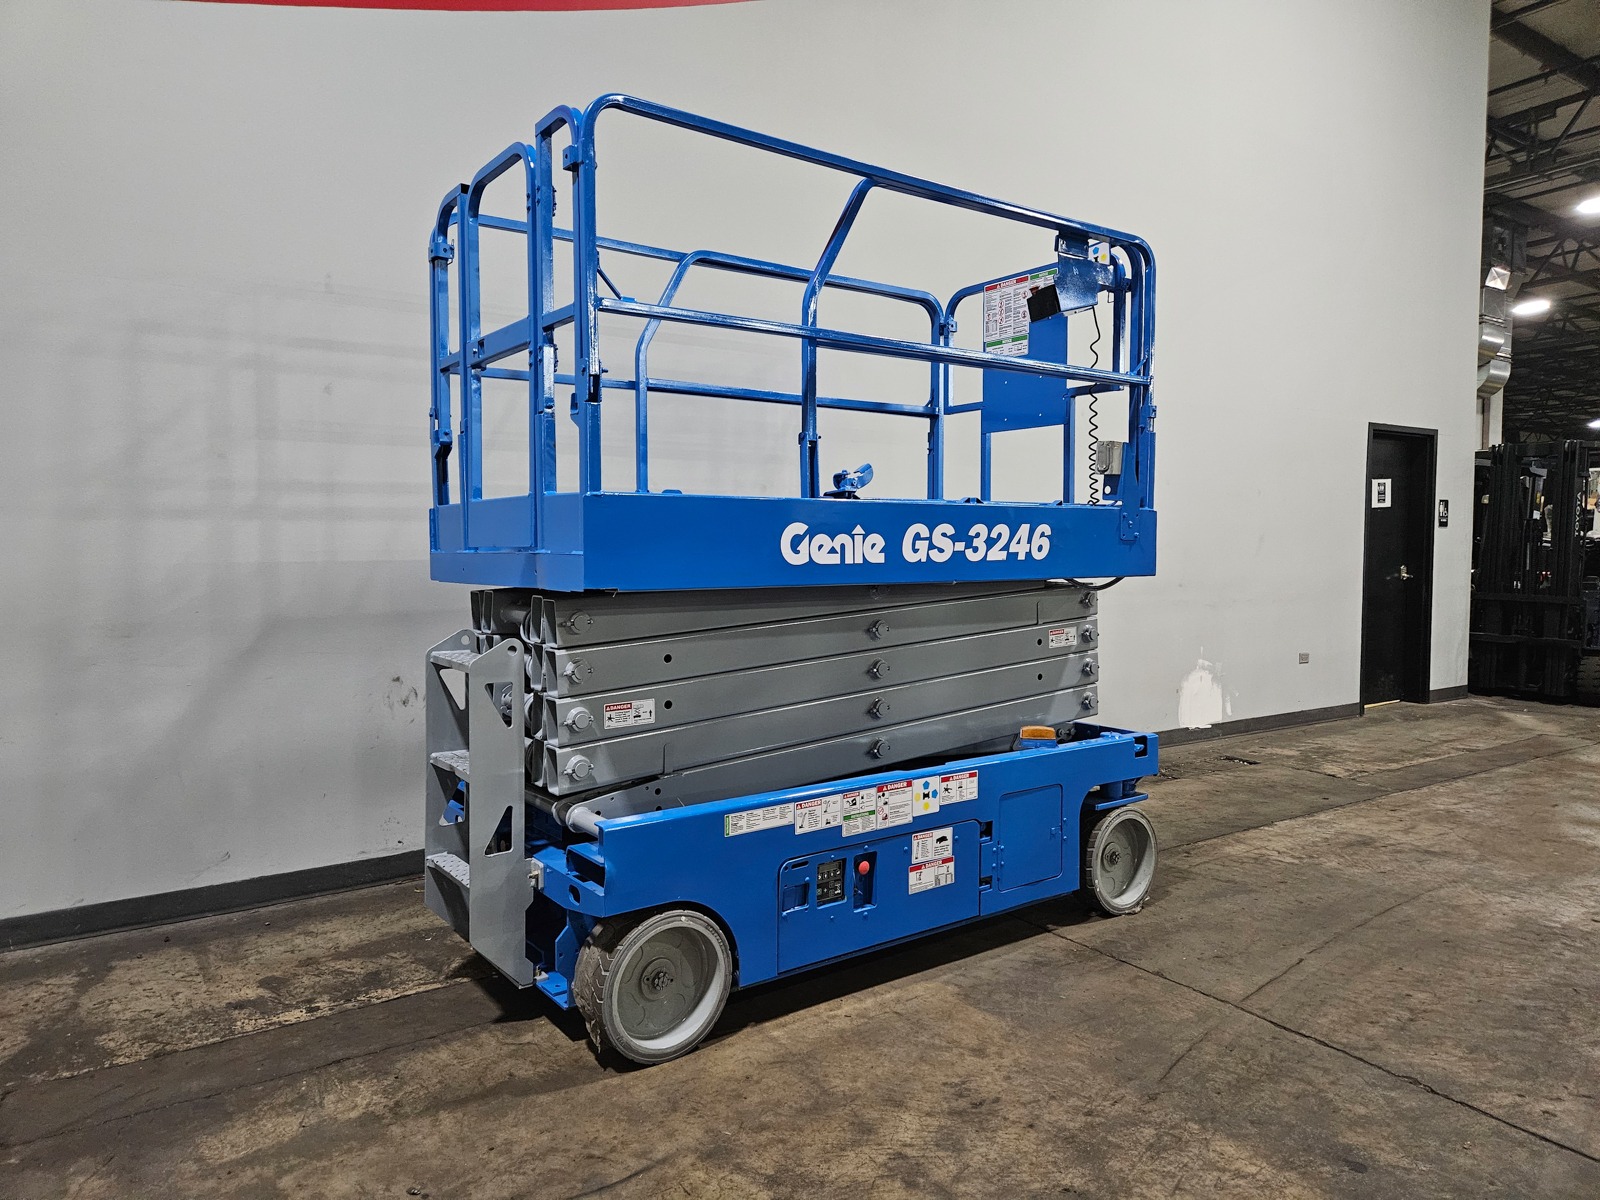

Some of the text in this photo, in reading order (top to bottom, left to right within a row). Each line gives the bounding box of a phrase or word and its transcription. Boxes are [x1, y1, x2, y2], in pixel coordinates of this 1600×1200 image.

[780, 521, 1052, 566] Genie GS-3246
[953, 773, 969, 781] DANGER
[887, 782, 907, 790] DANGER
[801, 800, 822, 809] DANGER
[925, 860, 943, 869] DANGER
